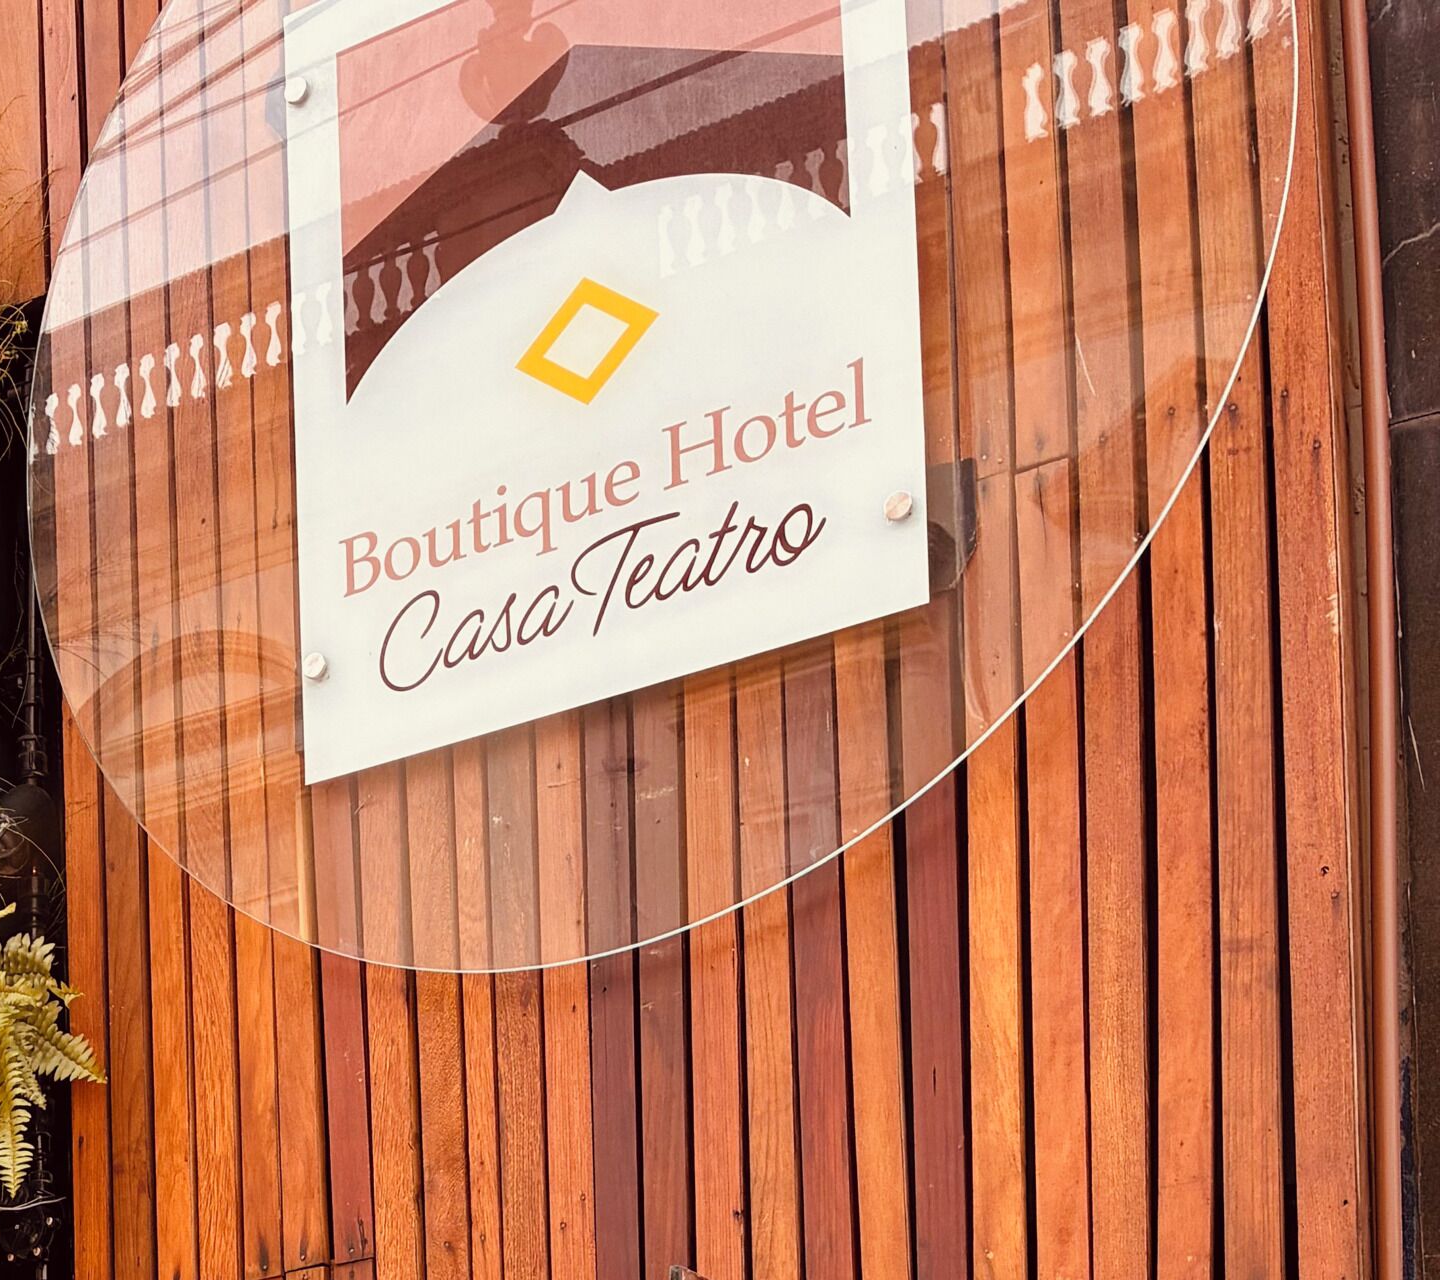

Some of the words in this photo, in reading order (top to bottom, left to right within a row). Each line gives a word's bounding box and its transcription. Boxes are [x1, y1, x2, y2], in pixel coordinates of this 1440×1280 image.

[340, 460, 641, 598] Boutique
[662, 356, 872, 491] Hotel
[380, 584, 574, 692] Casa
[570, 500, 826, 637] Teatro
